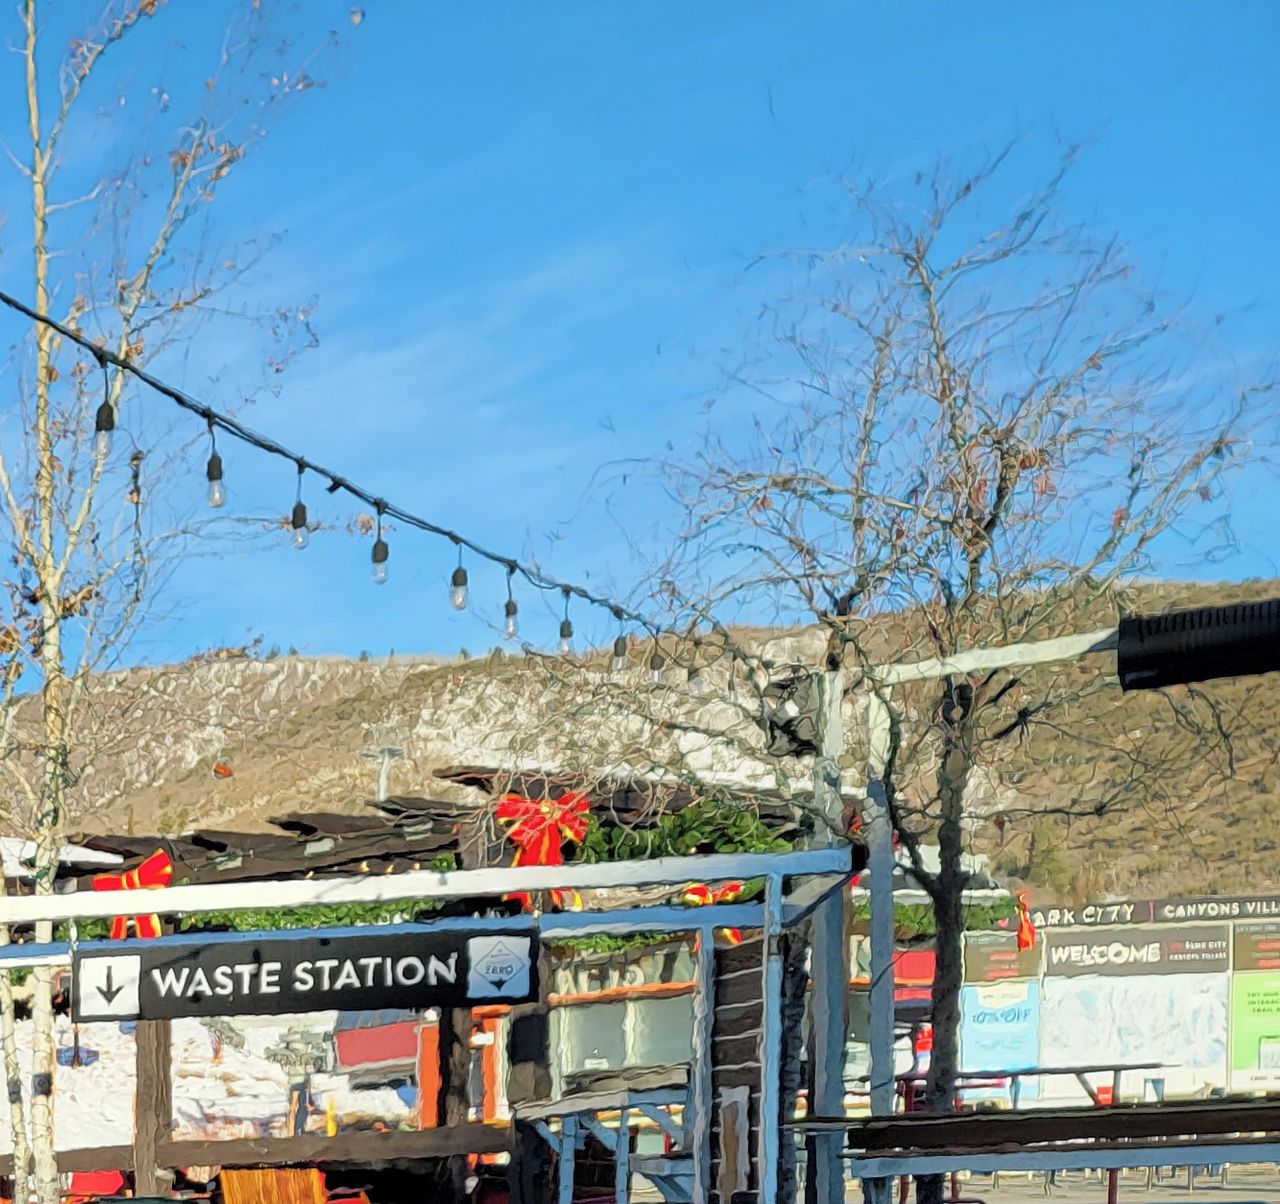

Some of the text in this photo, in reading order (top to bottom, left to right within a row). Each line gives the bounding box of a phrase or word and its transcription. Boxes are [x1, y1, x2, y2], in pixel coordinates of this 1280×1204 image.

[1030, 908, 1075, 927] ARK
[1083, 903, 1135, 924] CITY
[1164, 902, 1240, 919] CANYONS
[1050, 942, 1161, 966] WELCOME
[151, 951, 458, 998] WASTE STATION
